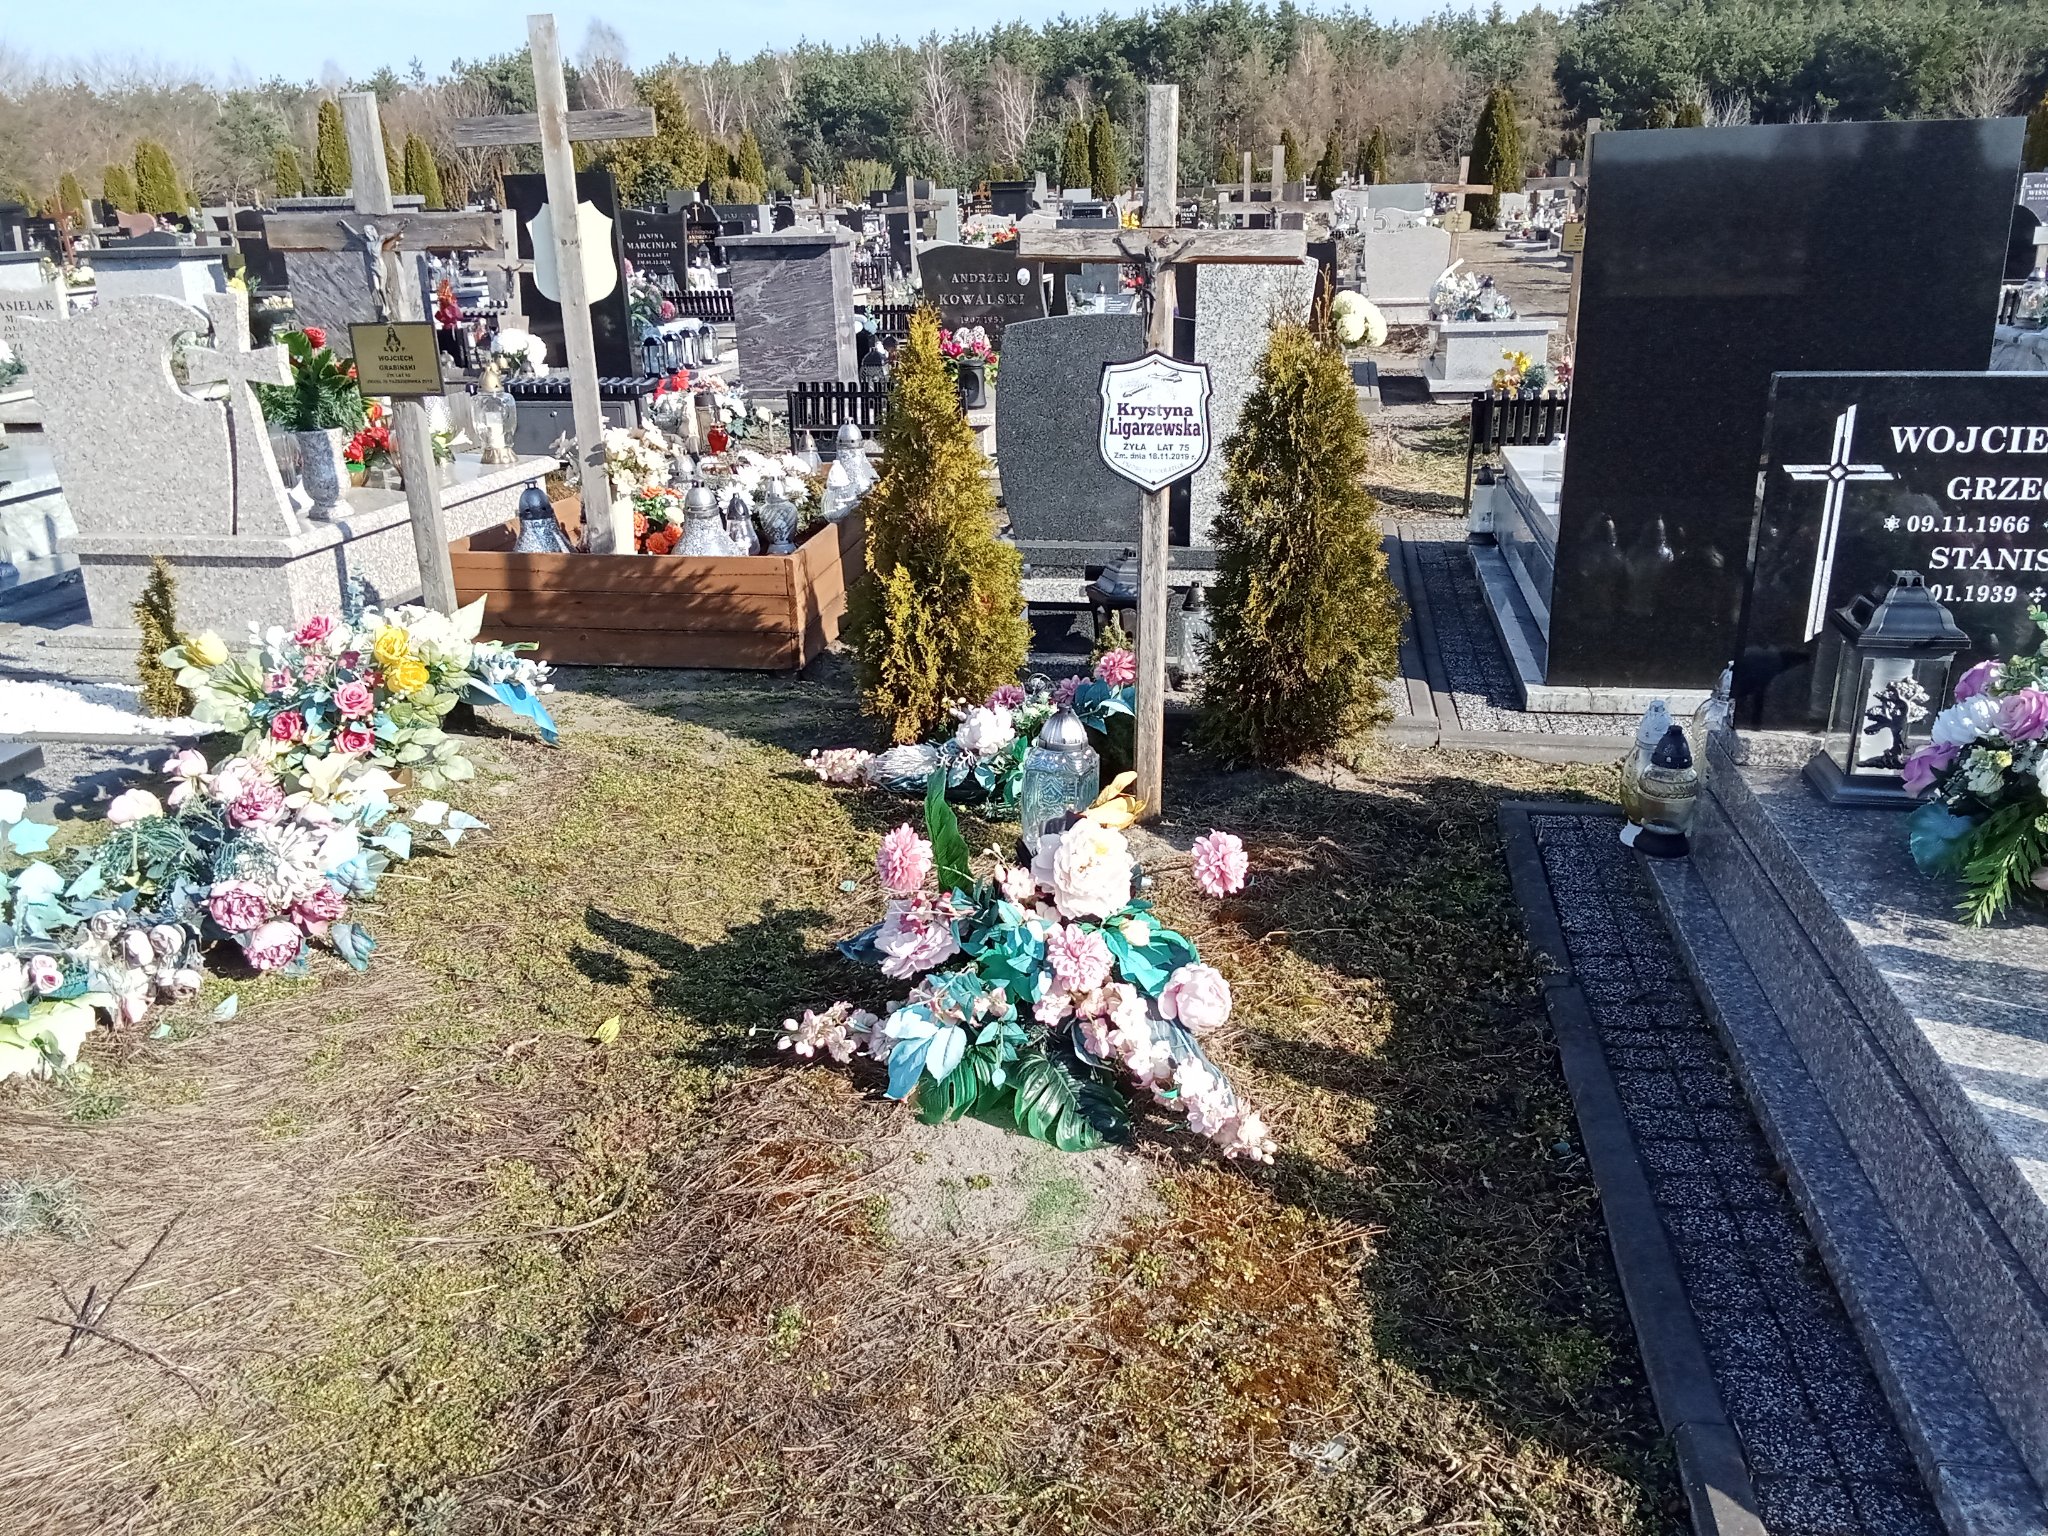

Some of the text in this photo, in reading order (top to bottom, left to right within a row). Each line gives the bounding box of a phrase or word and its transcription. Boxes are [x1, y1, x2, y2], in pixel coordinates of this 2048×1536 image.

[638, 232, 664, 240] JANINA
[626, 241, 678, 250] MARCINIAK
[951, 273, 1010, 284] ANDRZEJ
[939, 293, 1025, 305] KOWALSKI
[378, 363, 416, 371] GRABIŃSKI
[1116, 402, 1194, 420] Krystyna
[1109, 416, 1201, 440] Ligarzewska
[1890, 425, 2048, 453] WOJCIE
[1157, 443, 1174, 451] LAT
[1179, 443, 1190, 452] 75
[1130, 452, 1146, 460] dnia
[1946, 476, 2048, 500] GRZE
[1906, 514, 2031, 533] 09.11.1966
[1928, 546, 2048, 571] STANIS
[1930, 583, 2018, 603] 01.1939
